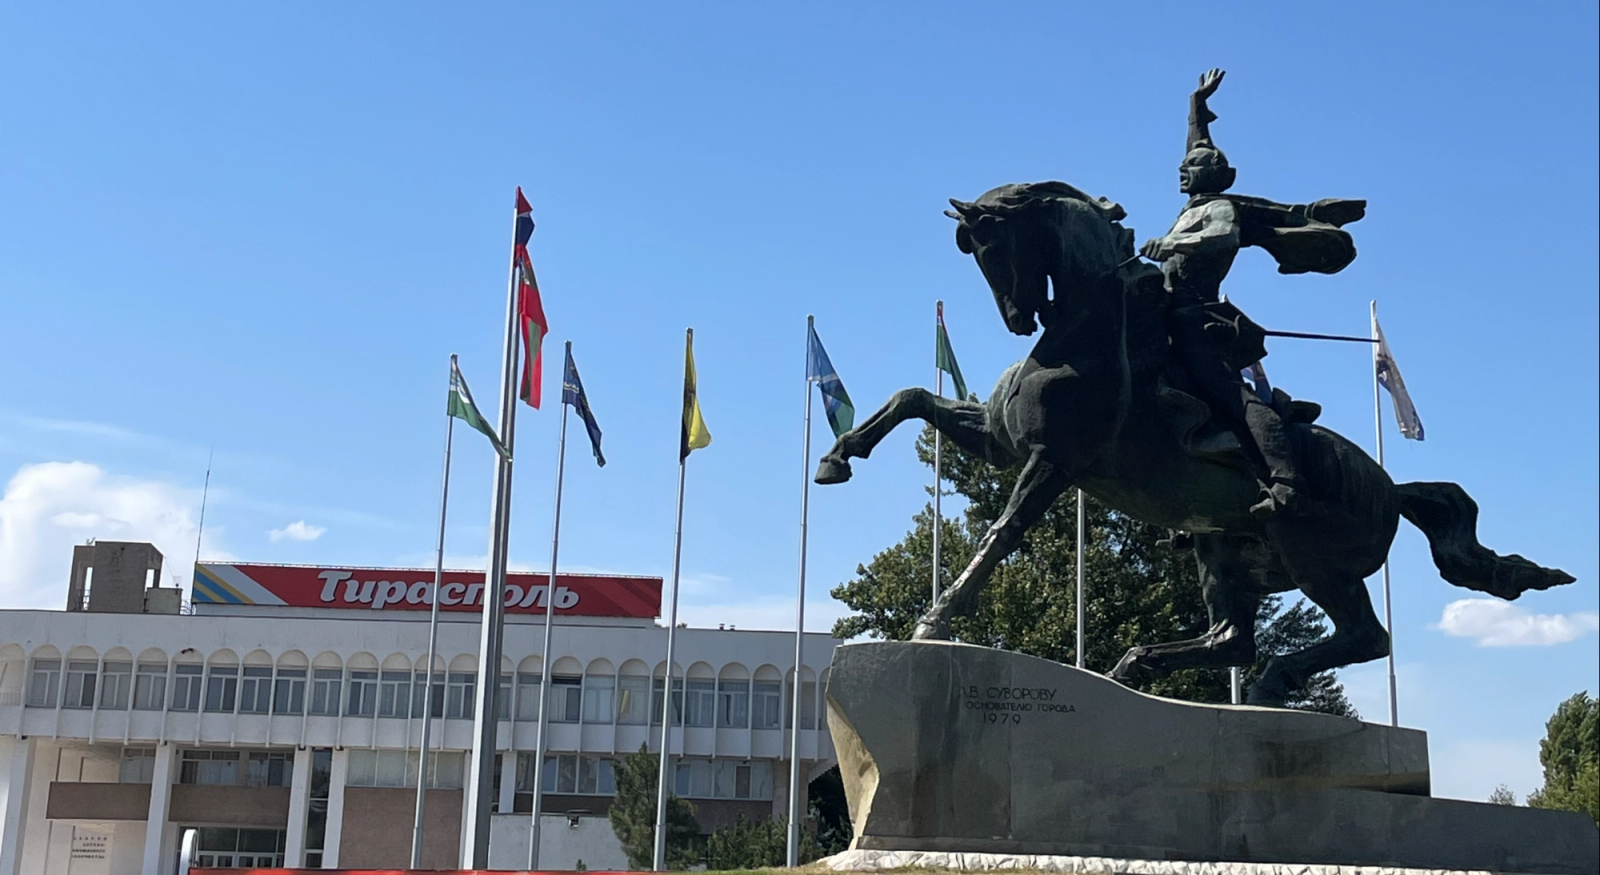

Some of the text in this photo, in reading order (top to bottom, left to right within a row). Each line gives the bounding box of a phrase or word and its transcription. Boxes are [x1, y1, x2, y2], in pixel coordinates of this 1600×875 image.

[317, 570, 580, 610] Тирасполь
[987, 686, 1057, 700] СУВОРОВУ
[965, 701, 1076, 713] ОСНОВАТЕЛЮ ГОРОДА
[983, 712, 1021, 725] 1979
